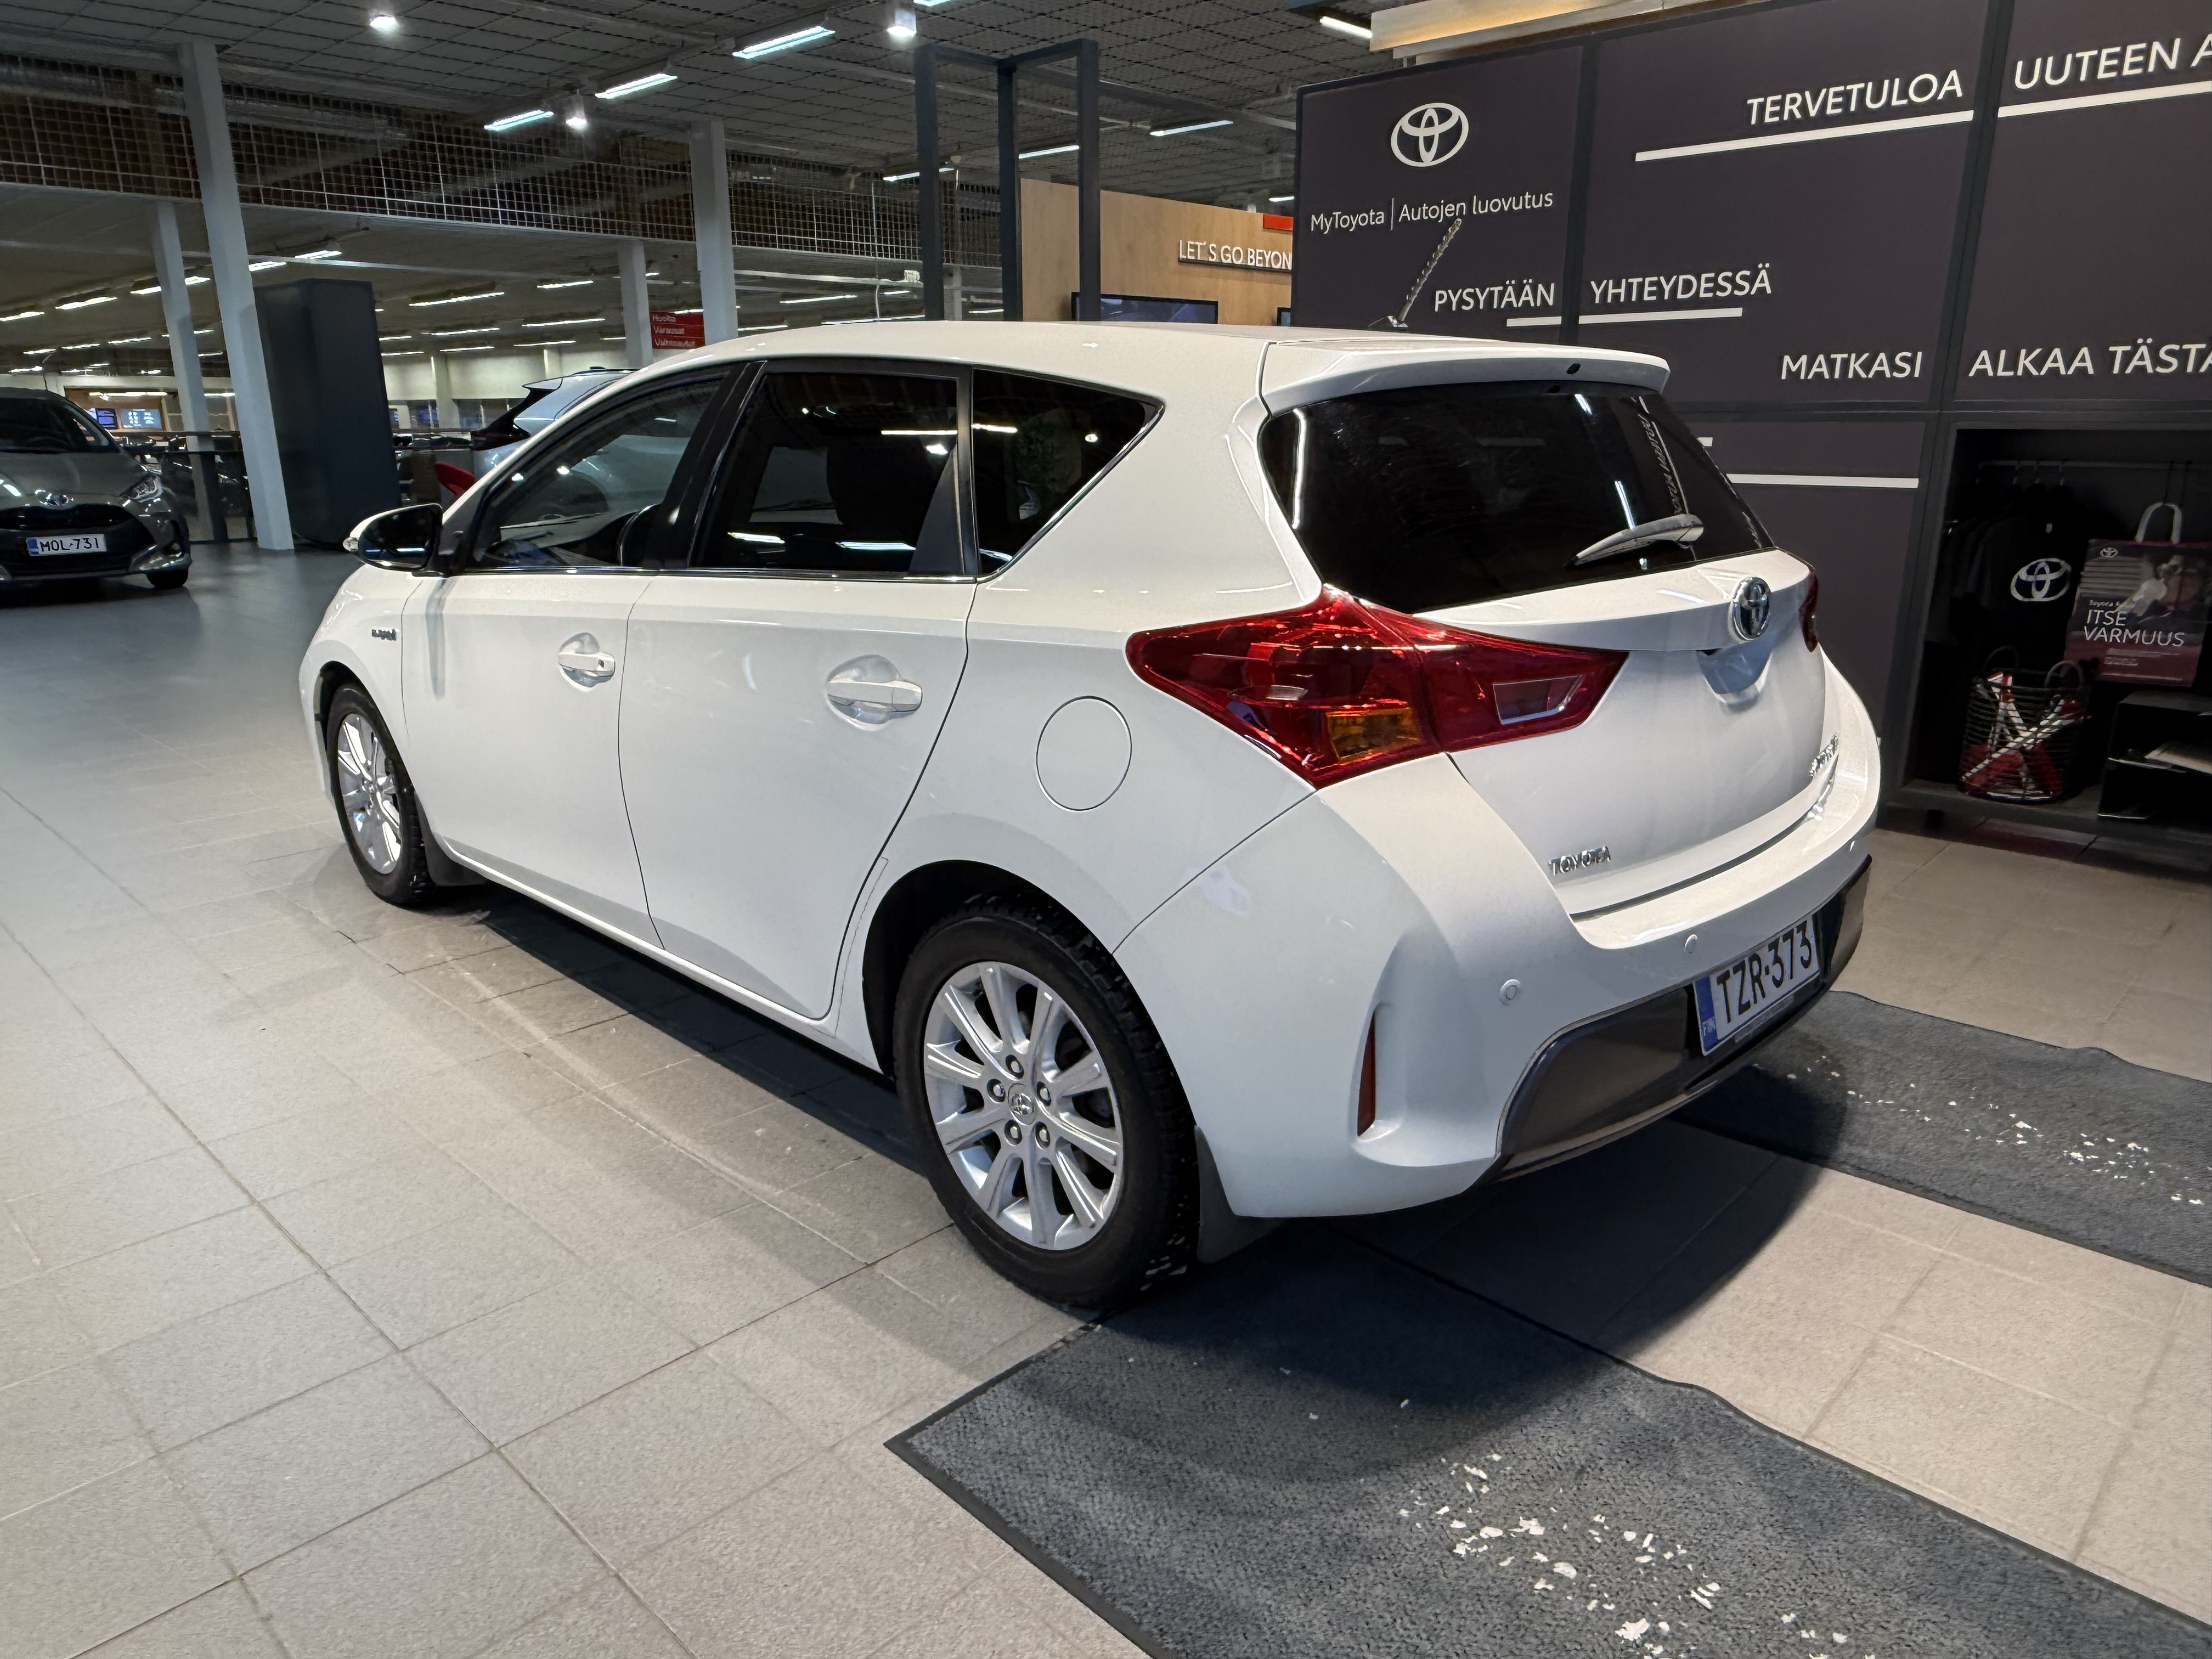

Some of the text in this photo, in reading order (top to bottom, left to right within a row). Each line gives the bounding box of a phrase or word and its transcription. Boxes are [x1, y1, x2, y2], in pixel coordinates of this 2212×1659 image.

[1747, 69, 1963, 125] TERVETULOA
[2015, 38, 2181, 90] UUTEEN
[1311, 191, 1553, 235] MyToyota Autojen luovutus
[1221, 245, 1243, 264] GO
[1435, 263, 1772, 312] PYSYTÄÄN YHTEYDESSÄ
[1781, 351, 1922, 380] MATKASI
[1968, 347, 2094, 377] ALKAA
[40, 538, 99, 552] MOL-731
[2086, 610, 2128, 627] ITSE
[2084, 625, 2186, 647] VARMUUS
[1549, 845, 1611, 876] TOYOTA
[1717, 920, 1812, 1024] TZR-373
